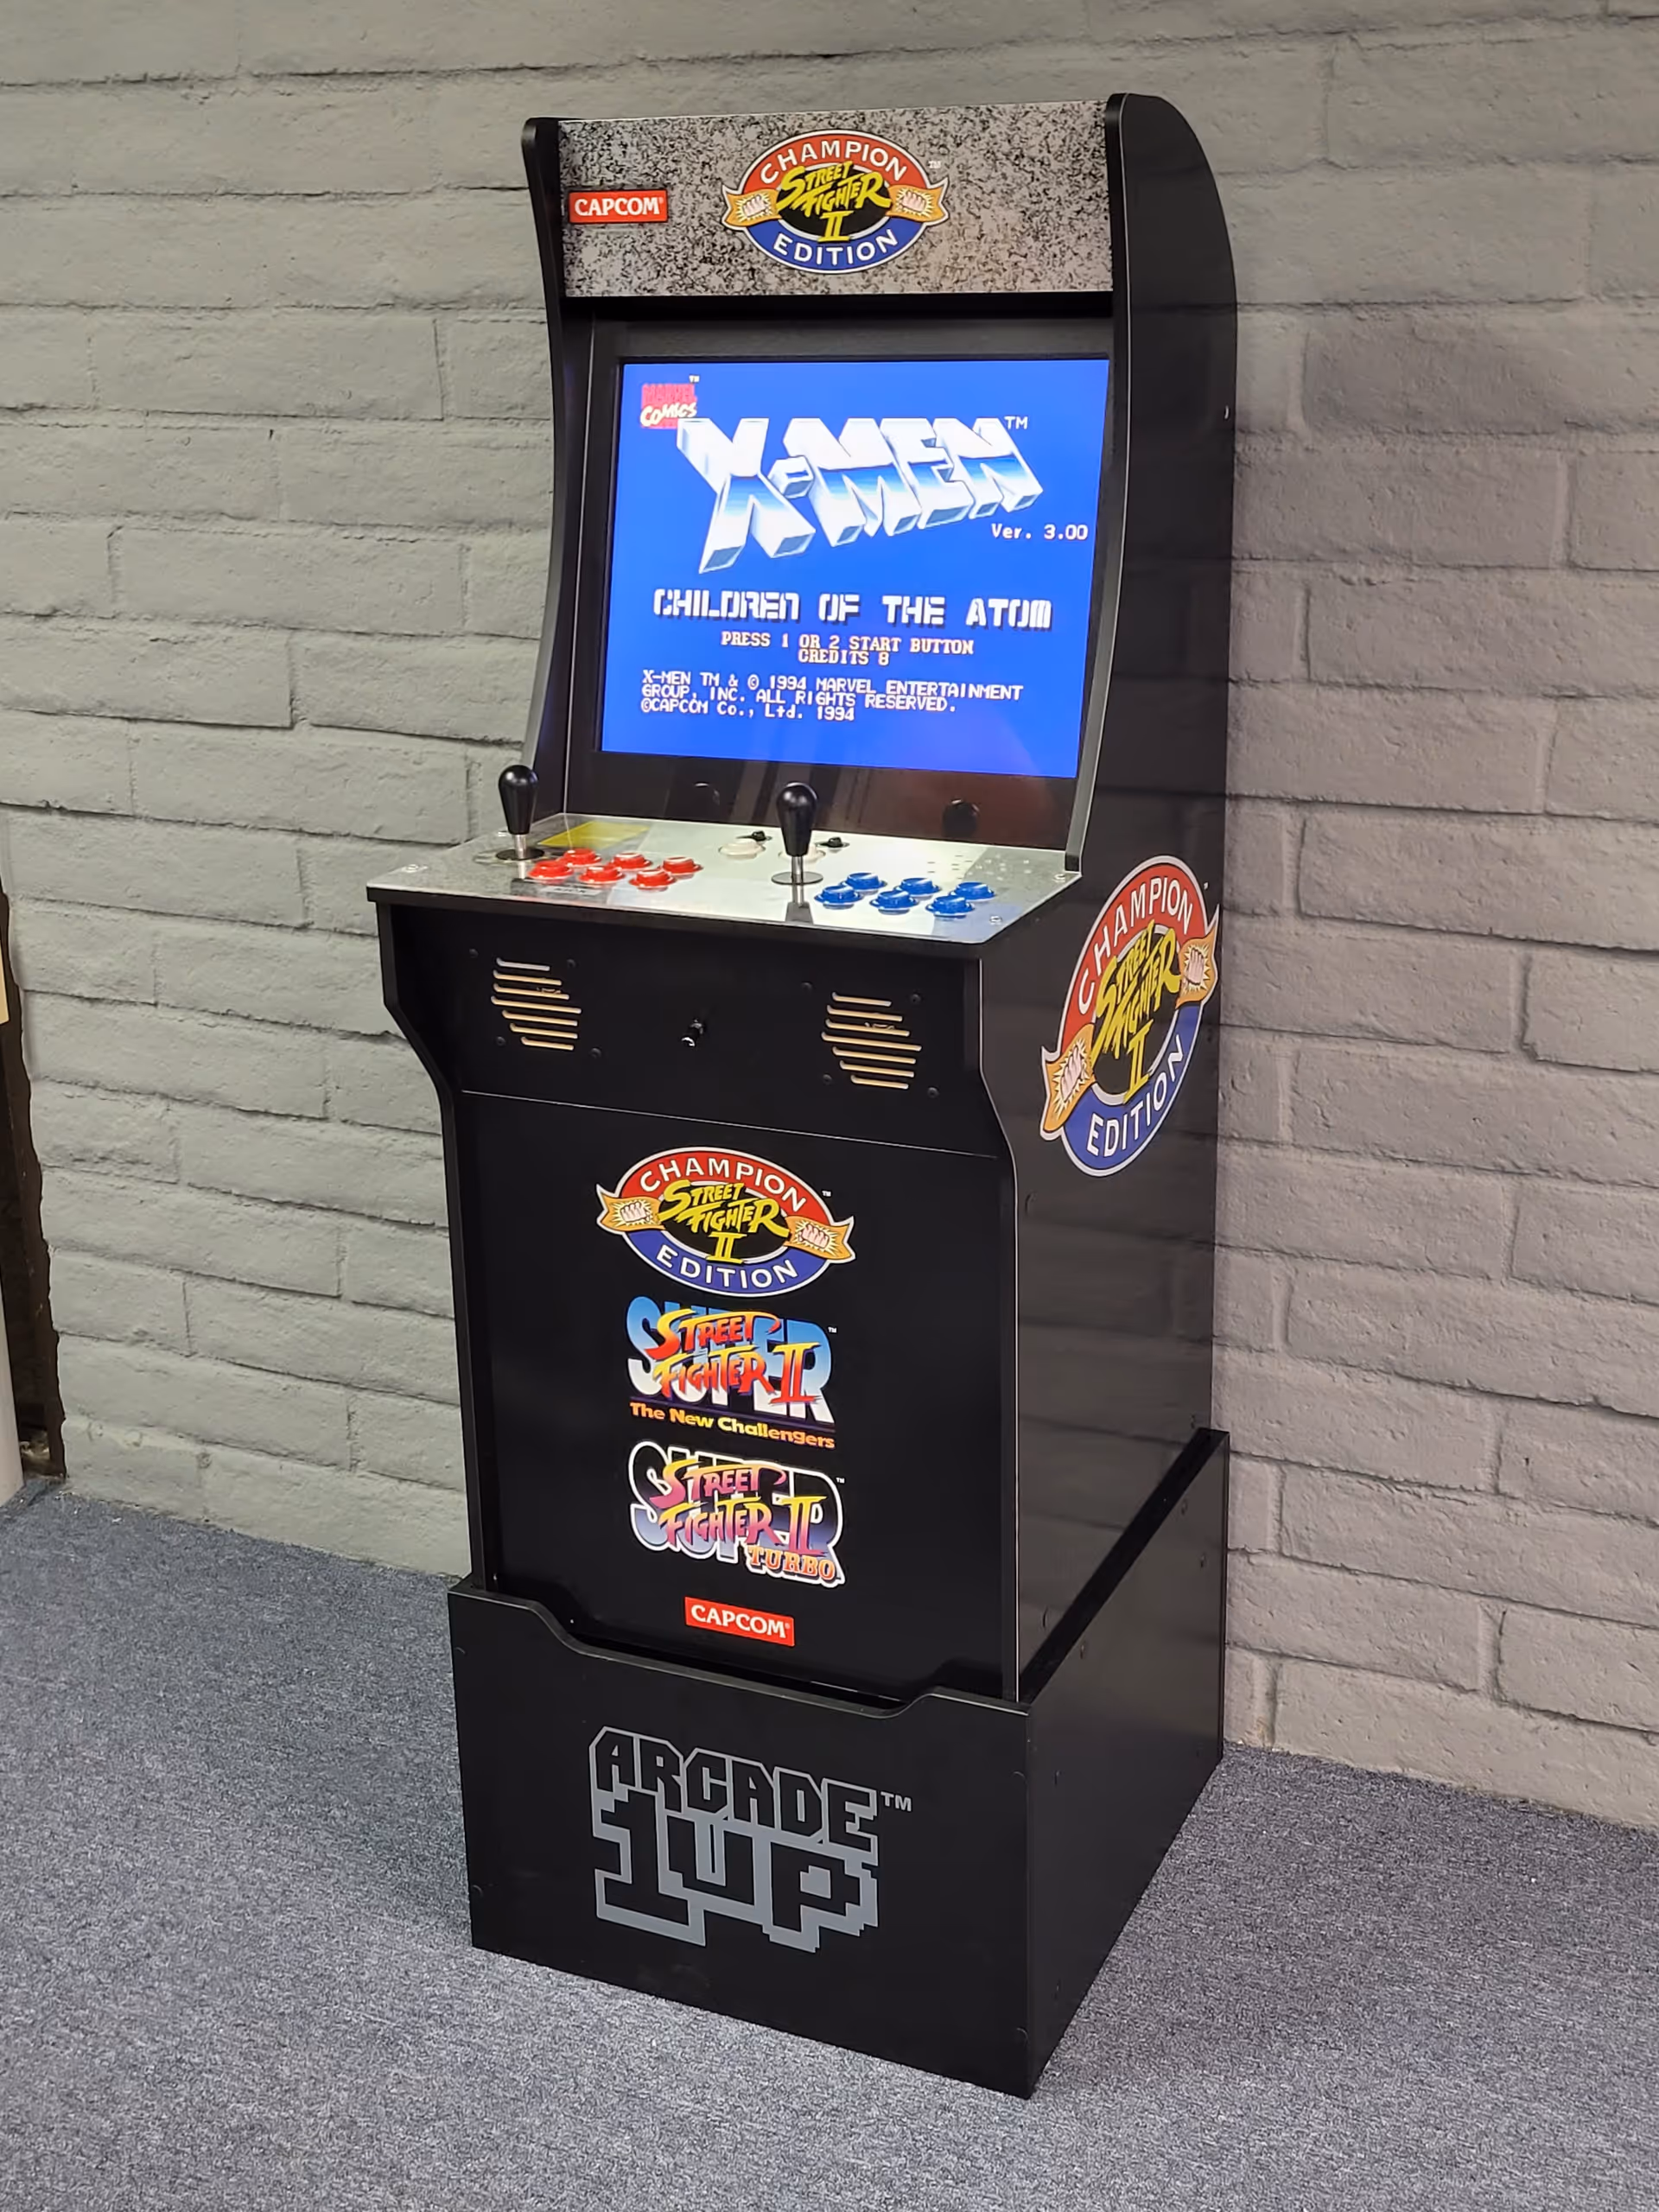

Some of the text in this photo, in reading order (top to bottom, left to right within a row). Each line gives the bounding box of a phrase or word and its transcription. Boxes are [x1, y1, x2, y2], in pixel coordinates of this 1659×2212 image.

[760, 139, 908, 185] CHAMPION
[776, 161, 853, 212] STREET
[800, 171, 893, 218] FIGHTER
[772, 228, 899, 266] EDITION
[817, 210, 850, 243] II
[1004, 416, 1028, 430] TM
[676, 417, 1043, 574] X-MEN
[991, 523, 1089, 540] Ver. 3.00
[653, 588, 1052, 629] CHILDREN OF THE ATOM
[721, 631, 975, 655] PRESS 1 OR 2 START BUTTON
[798, 648, 889, 666] CREDITS 8
[642, 669, 691, 685] X-MEN
[699, 671, 720, 687] TM
[728, 674, 739, 688] &
[769, 675, 807, 690] 1994
[816, 677, 876, 695] MARVEL
[886, 679, 1024, 701] ENTERTAINMENT
[709, 686, 746, 702] INC.
[755, 689, 786, 704] ALL
[795, 690, 855, 707] RIGHTS
[865, 694, 956, 713] RESERVED.
[764, 703, 803, 720] Ltd.
[817, 706, 855, 721] 1994
[1077, 875, 1193, 1015] CHAMPION
[1090, 918, 1156, 1068] STREET
[1102, 927, 1182, 1060] FIGHTER
[1122, 1019, 1154, 1104] II
[1085, 1033, 1184, 1158] EDITION
[639, 1157, 807, 1212] CHAMPION
[657, 1179, 745, 1223] STREET
[673, 1197, 791, 1238] FIGHTER
[656, 1244, 798, 1289] EDITION
[705, 1230, 747, 1265] II
[645, 1308, 781, 1362] STREET
[652, 1341, 823, 1405] FIGHTER II
[629, 1402, 836, 1449] The New Challengers
[648, 1459, 787, 1510] STREET
[658, 1496, 828, 1556] FIGHTER II
[747, 1544, 836, 1580] TURBO
[588, 1726, 878, 1859] ARCADE
[880, 1790, 912, 1813] TM
[593, 1789, 878, 1953] 1UP
